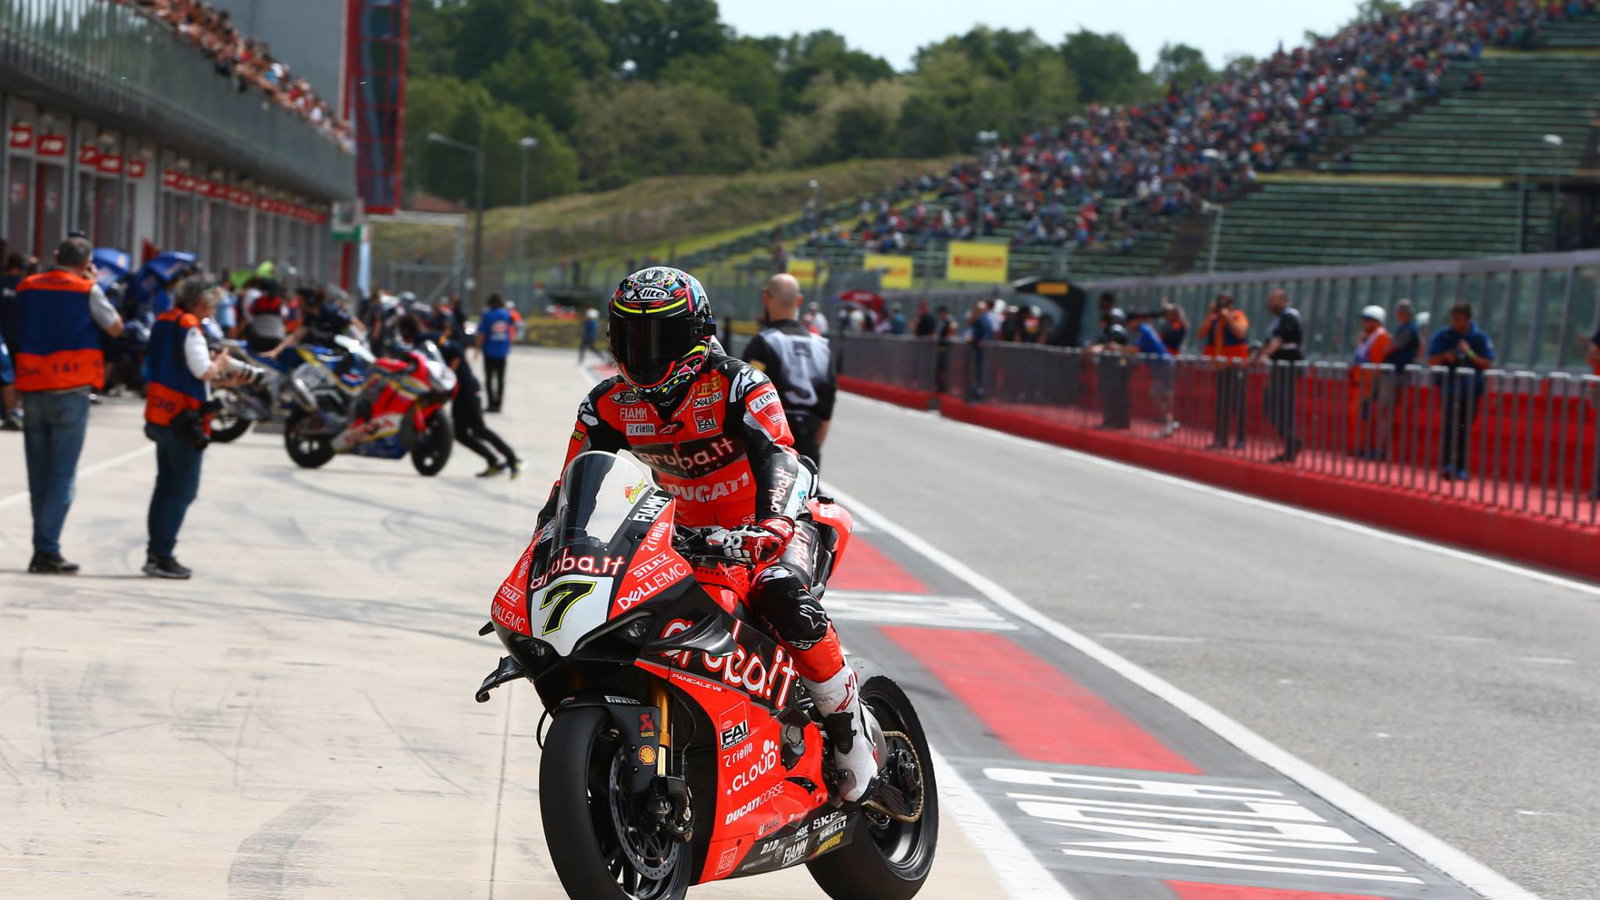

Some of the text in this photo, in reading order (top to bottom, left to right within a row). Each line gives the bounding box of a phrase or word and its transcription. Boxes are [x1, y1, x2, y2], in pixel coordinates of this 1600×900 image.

[629, 287, 664, 300] X-lite
[620, 407, 648, 419] FIAMM
[635, 424, 654, 434] riello
[640, 438, 734, 471] aruba.it
[665, 471, 749, 503] DUCATI
[632, 493, 670, 522] FIAMM
[530, 547, 625, 590] aruba.it
[633, 552, 670, 578] STULZ
[541, 580, 598, 636] 7
[661, 618, 797, 710] aba.it
[721, 720, 747, 744] FAI
[812, 811, 839, 830] SKF
